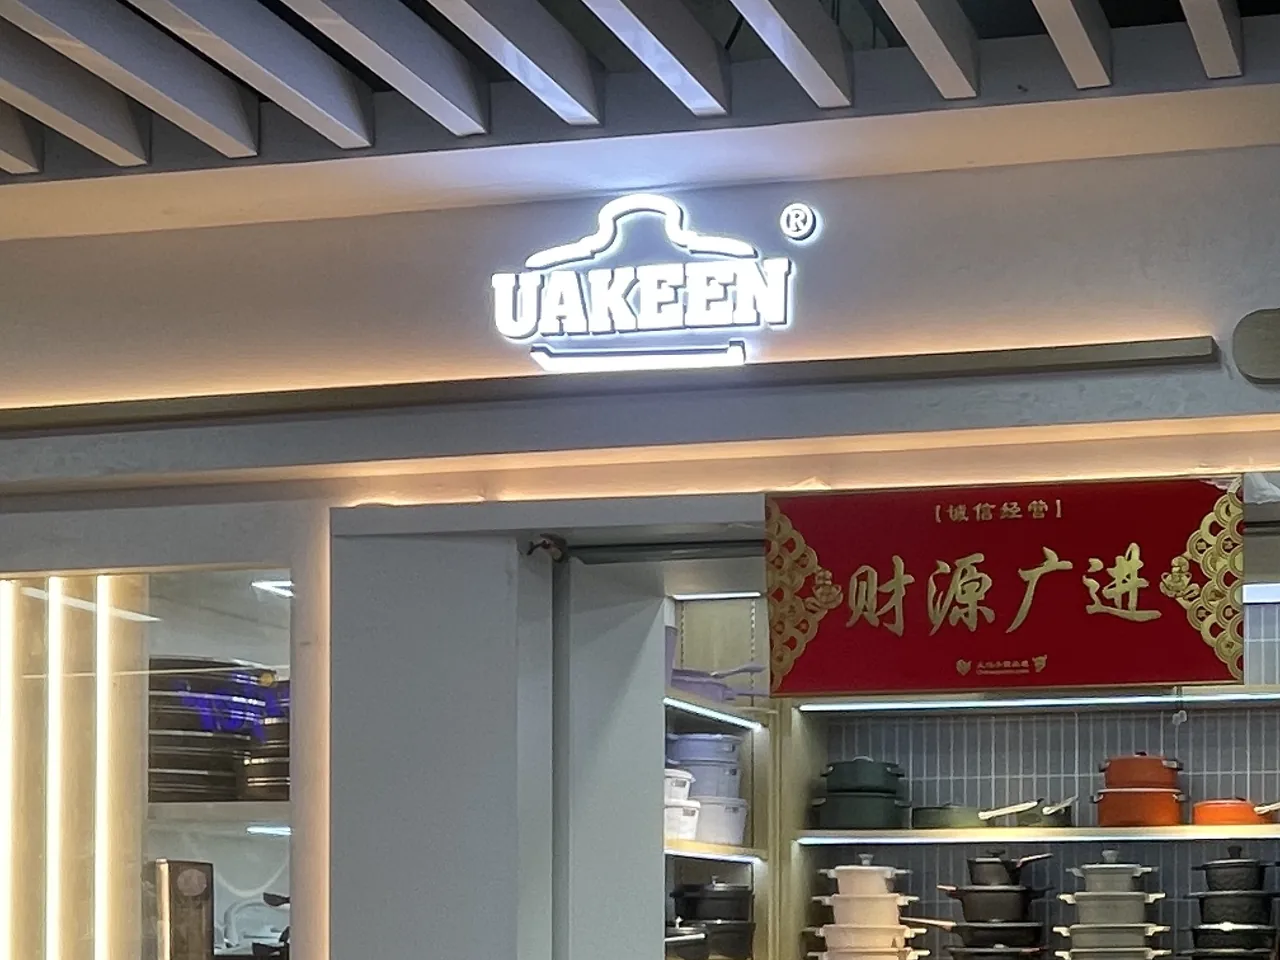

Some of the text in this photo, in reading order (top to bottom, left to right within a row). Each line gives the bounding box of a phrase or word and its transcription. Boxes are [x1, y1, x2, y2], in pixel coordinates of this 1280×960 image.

[491, 256, 792, 340] UAKEEN
[845, 542, 1162, 637] 财源广进
